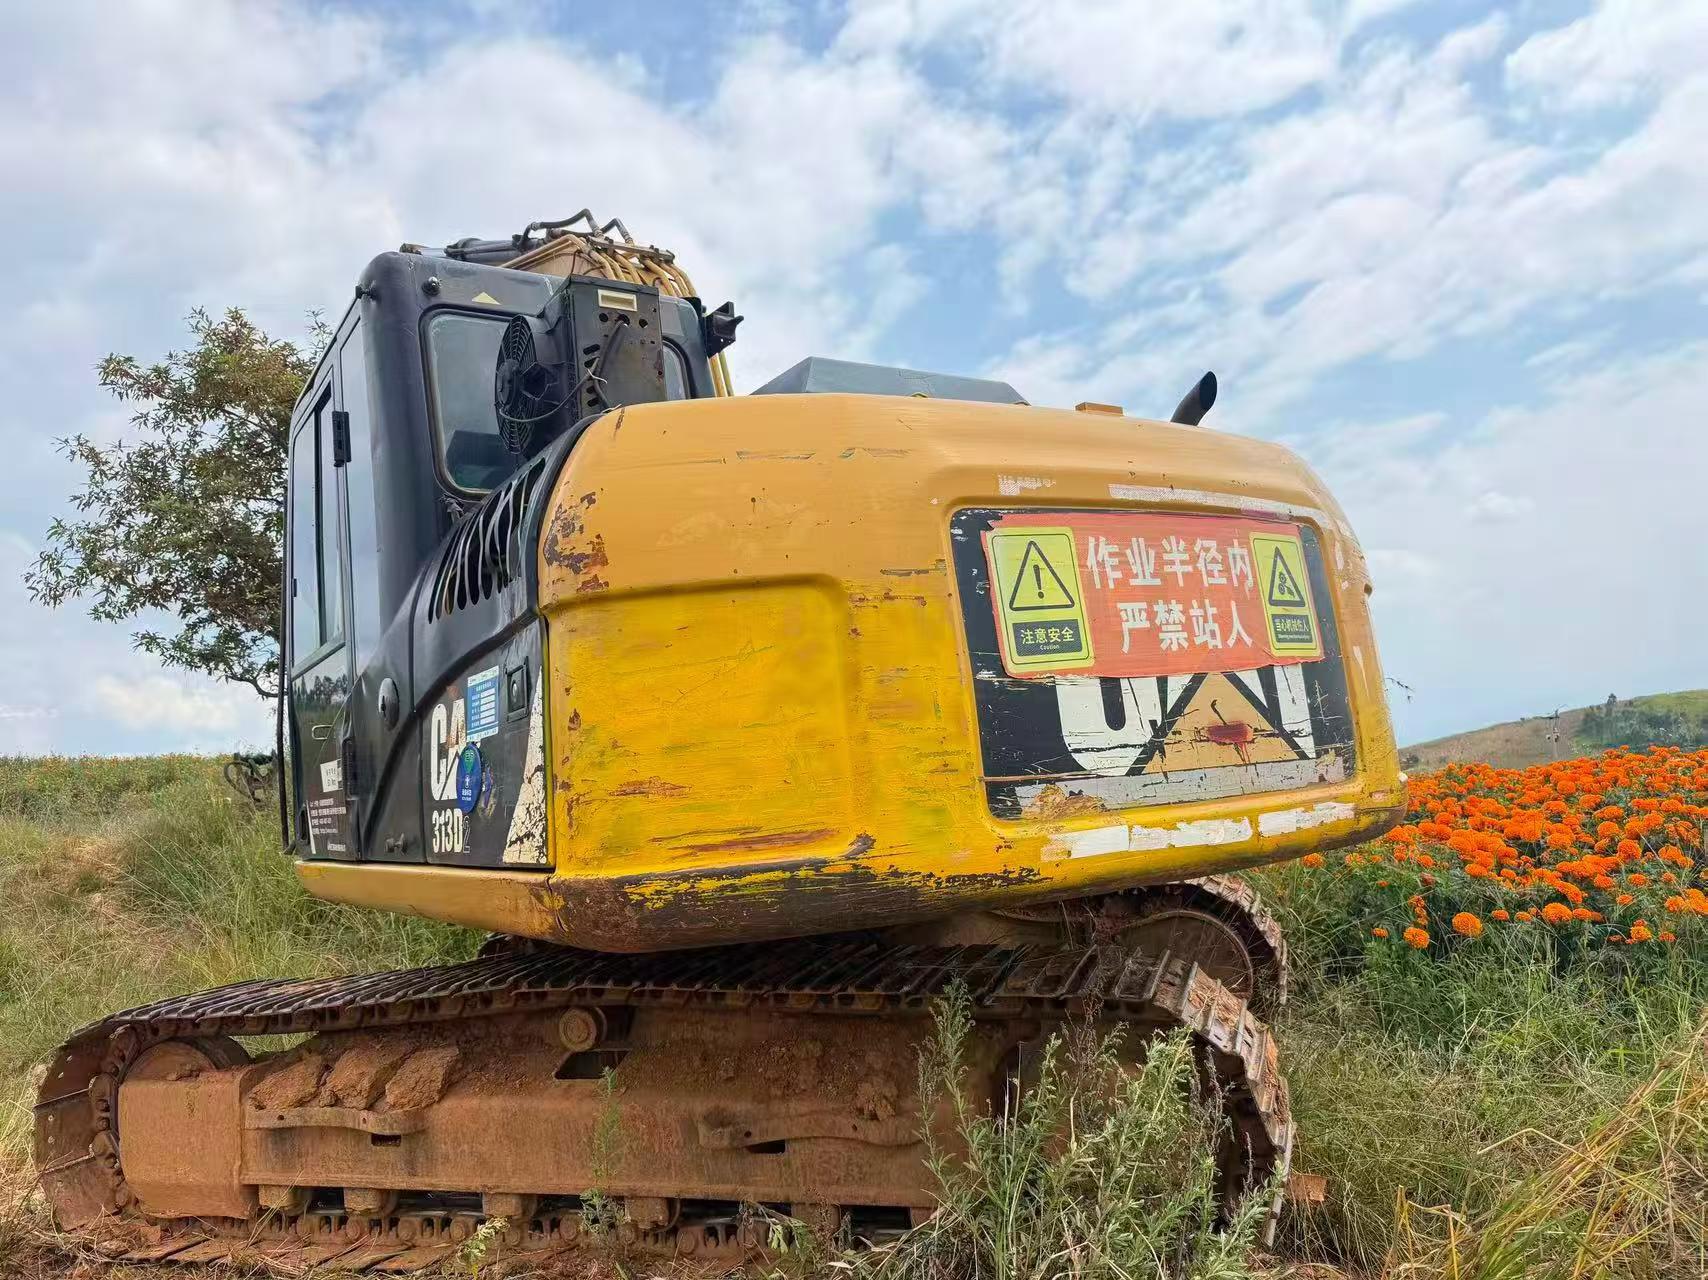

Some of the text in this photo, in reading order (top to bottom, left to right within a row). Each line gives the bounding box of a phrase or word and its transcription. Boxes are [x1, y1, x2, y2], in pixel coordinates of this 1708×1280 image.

[1087, 536, 1254, 590] 作业半径内
[1020, 626, 1075, 645] 注意安全
[1116, 599, 1253, 654] 严禁站人
[431, 697, 475, 801] CA
